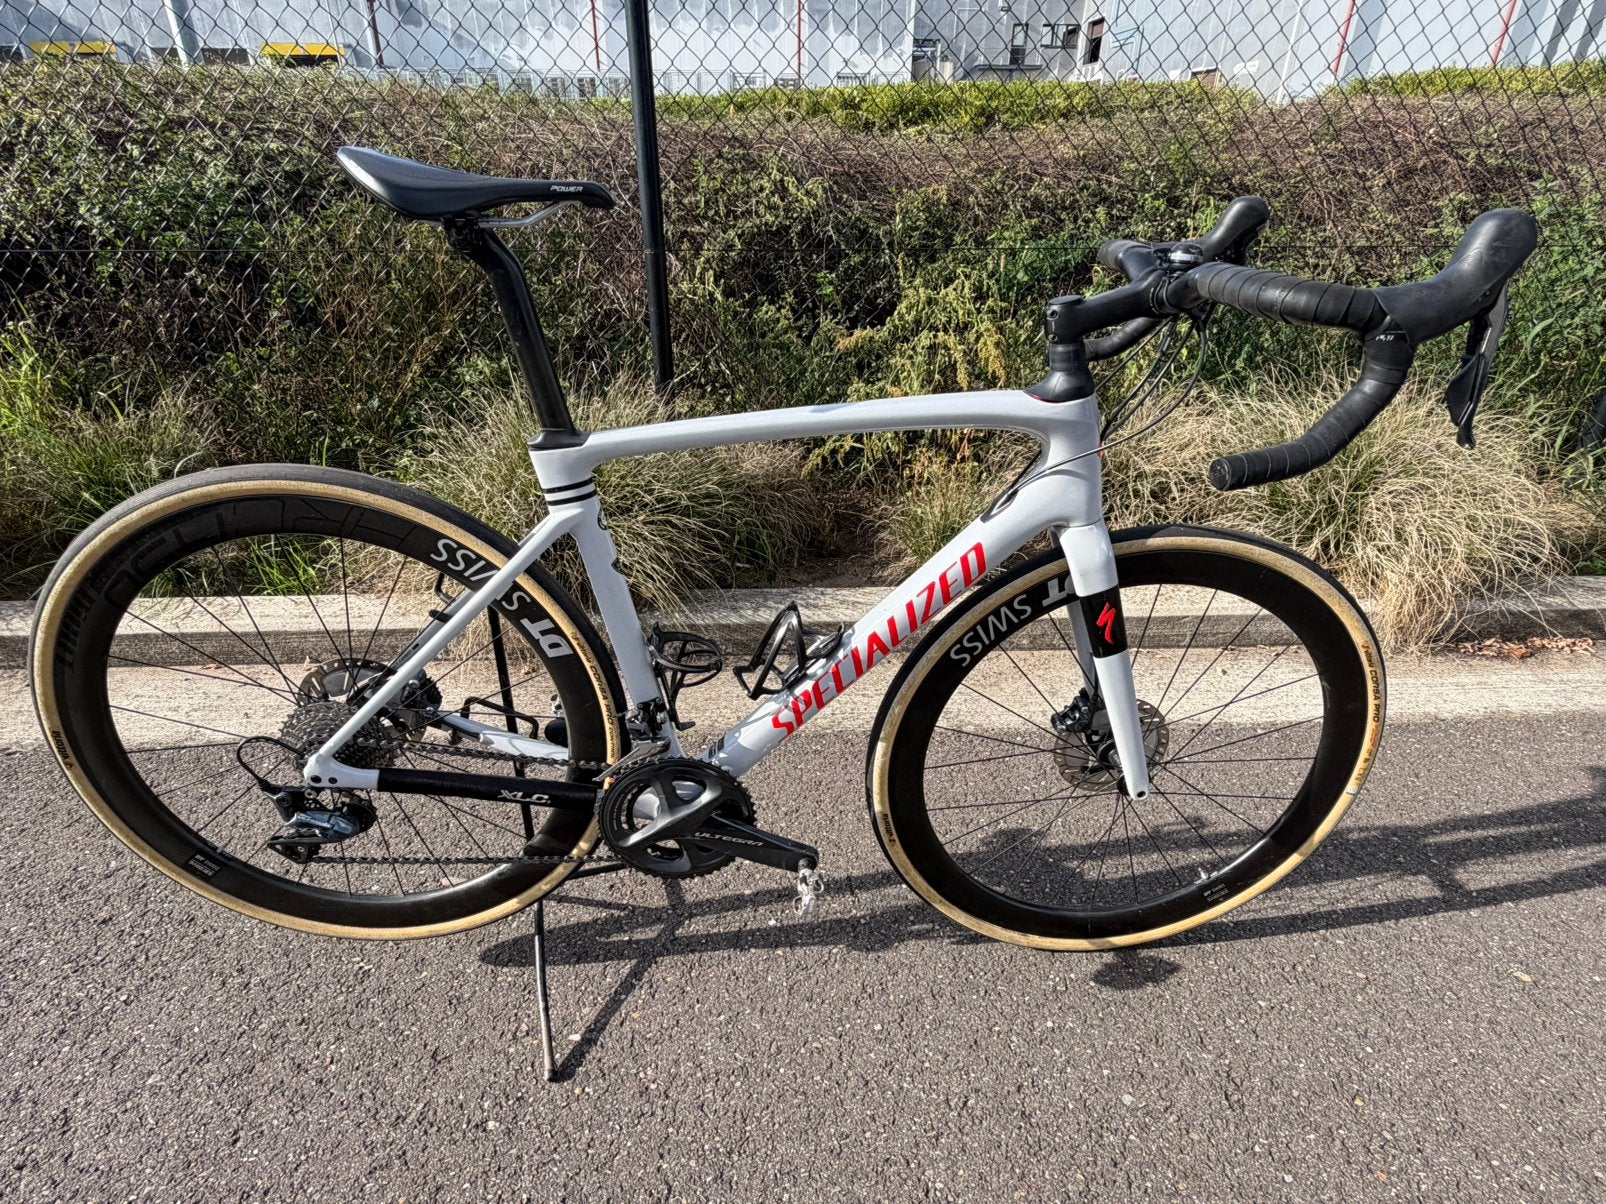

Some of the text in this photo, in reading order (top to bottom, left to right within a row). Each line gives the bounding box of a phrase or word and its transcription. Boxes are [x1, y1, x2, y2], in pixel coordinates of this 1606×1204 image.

[430, 539, 531, 611] SISS
[520, 618, 573, 658] DT
[772, 542, 986, 743] SPECIALIZED
[950, 594, 1031, 666] SWISS
[590, 665, 608, 700] CORSA
[604, 704, 614, 725] PRO
[1370, 670, 1380, 700] CORSA
[1372, 704, 1380, 722] PRO
[51, 731, 69, 759] vittoria
[694, 832, 764, 846] ULTEGRA
[882, 814, 893, 837] vittoria
